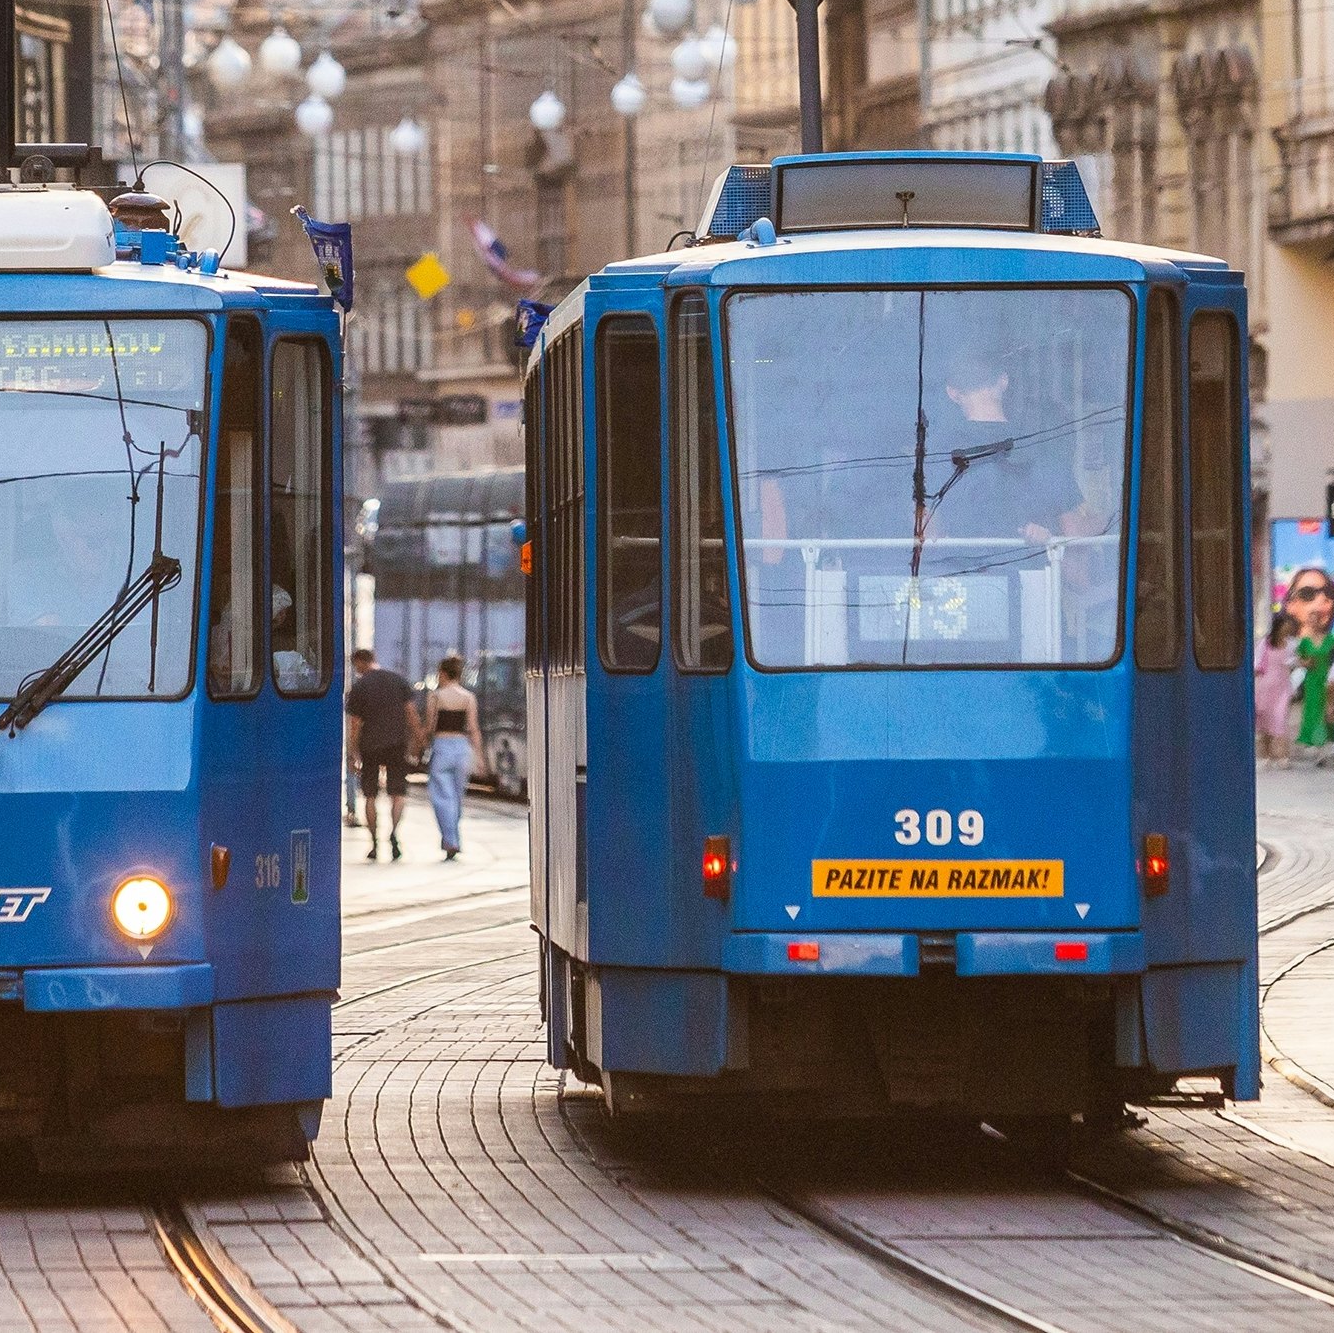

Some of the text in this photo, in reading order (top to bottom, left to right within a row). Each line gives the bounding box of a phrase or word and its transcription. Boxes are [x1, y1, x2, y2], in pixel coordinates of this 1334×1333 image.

[894, 809, 985, 847] 309
[825, 868, 1051, 891] PAZITE NA RAZMAK!
